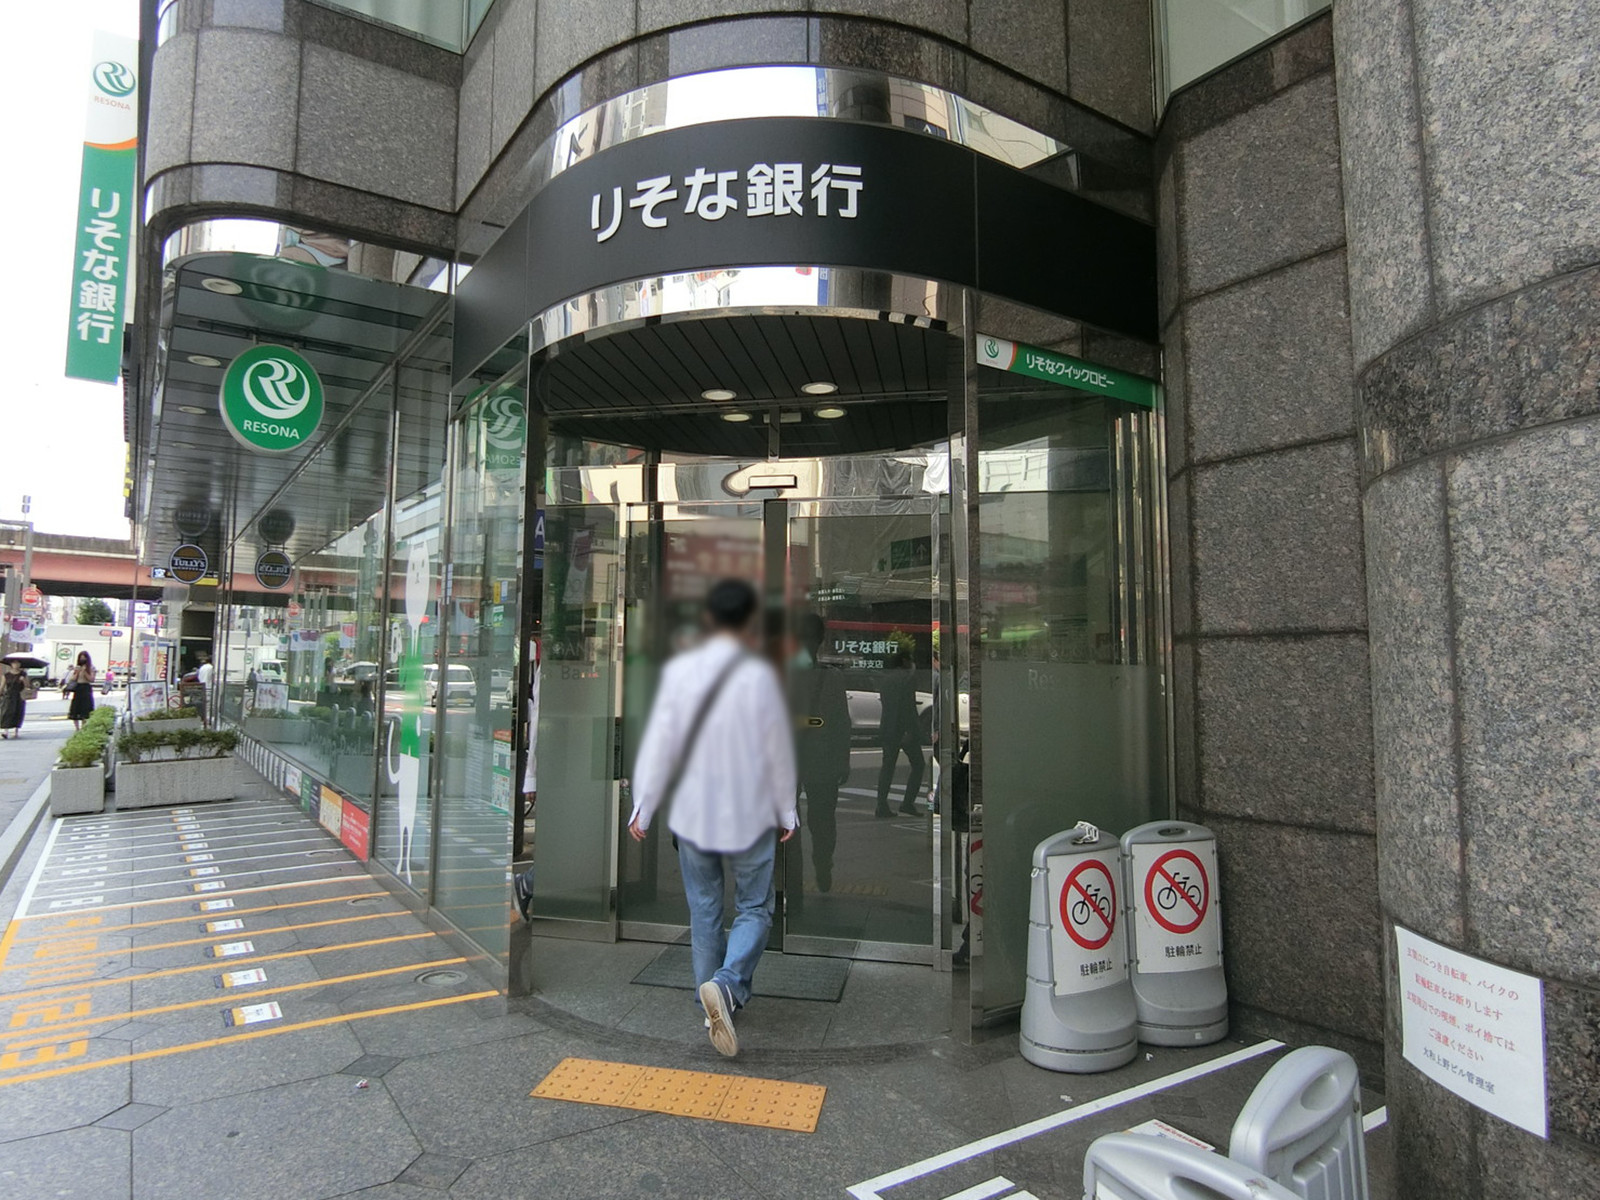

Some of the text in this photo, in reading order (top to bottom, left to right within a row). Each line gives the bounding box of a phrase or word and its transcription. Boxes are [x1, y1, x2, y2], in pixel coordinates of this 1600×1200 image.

[94, 95, 131, 110] RESONA
[590, 163, 864, 243] りそな銀行
[76, 187, 122, 344] りそな銀行
[1026, 353, 1115, 388] りそなクイックロビー
[243, 420, 300, 440] RESONA
[834, 640, 899, 654] りそな銀行
[850, 659, 884, 669] 上野支店
[1165, 943, 1203, 958] 駐輪禁止
[1080, 957, 1113, 977] 駐輪禁止
